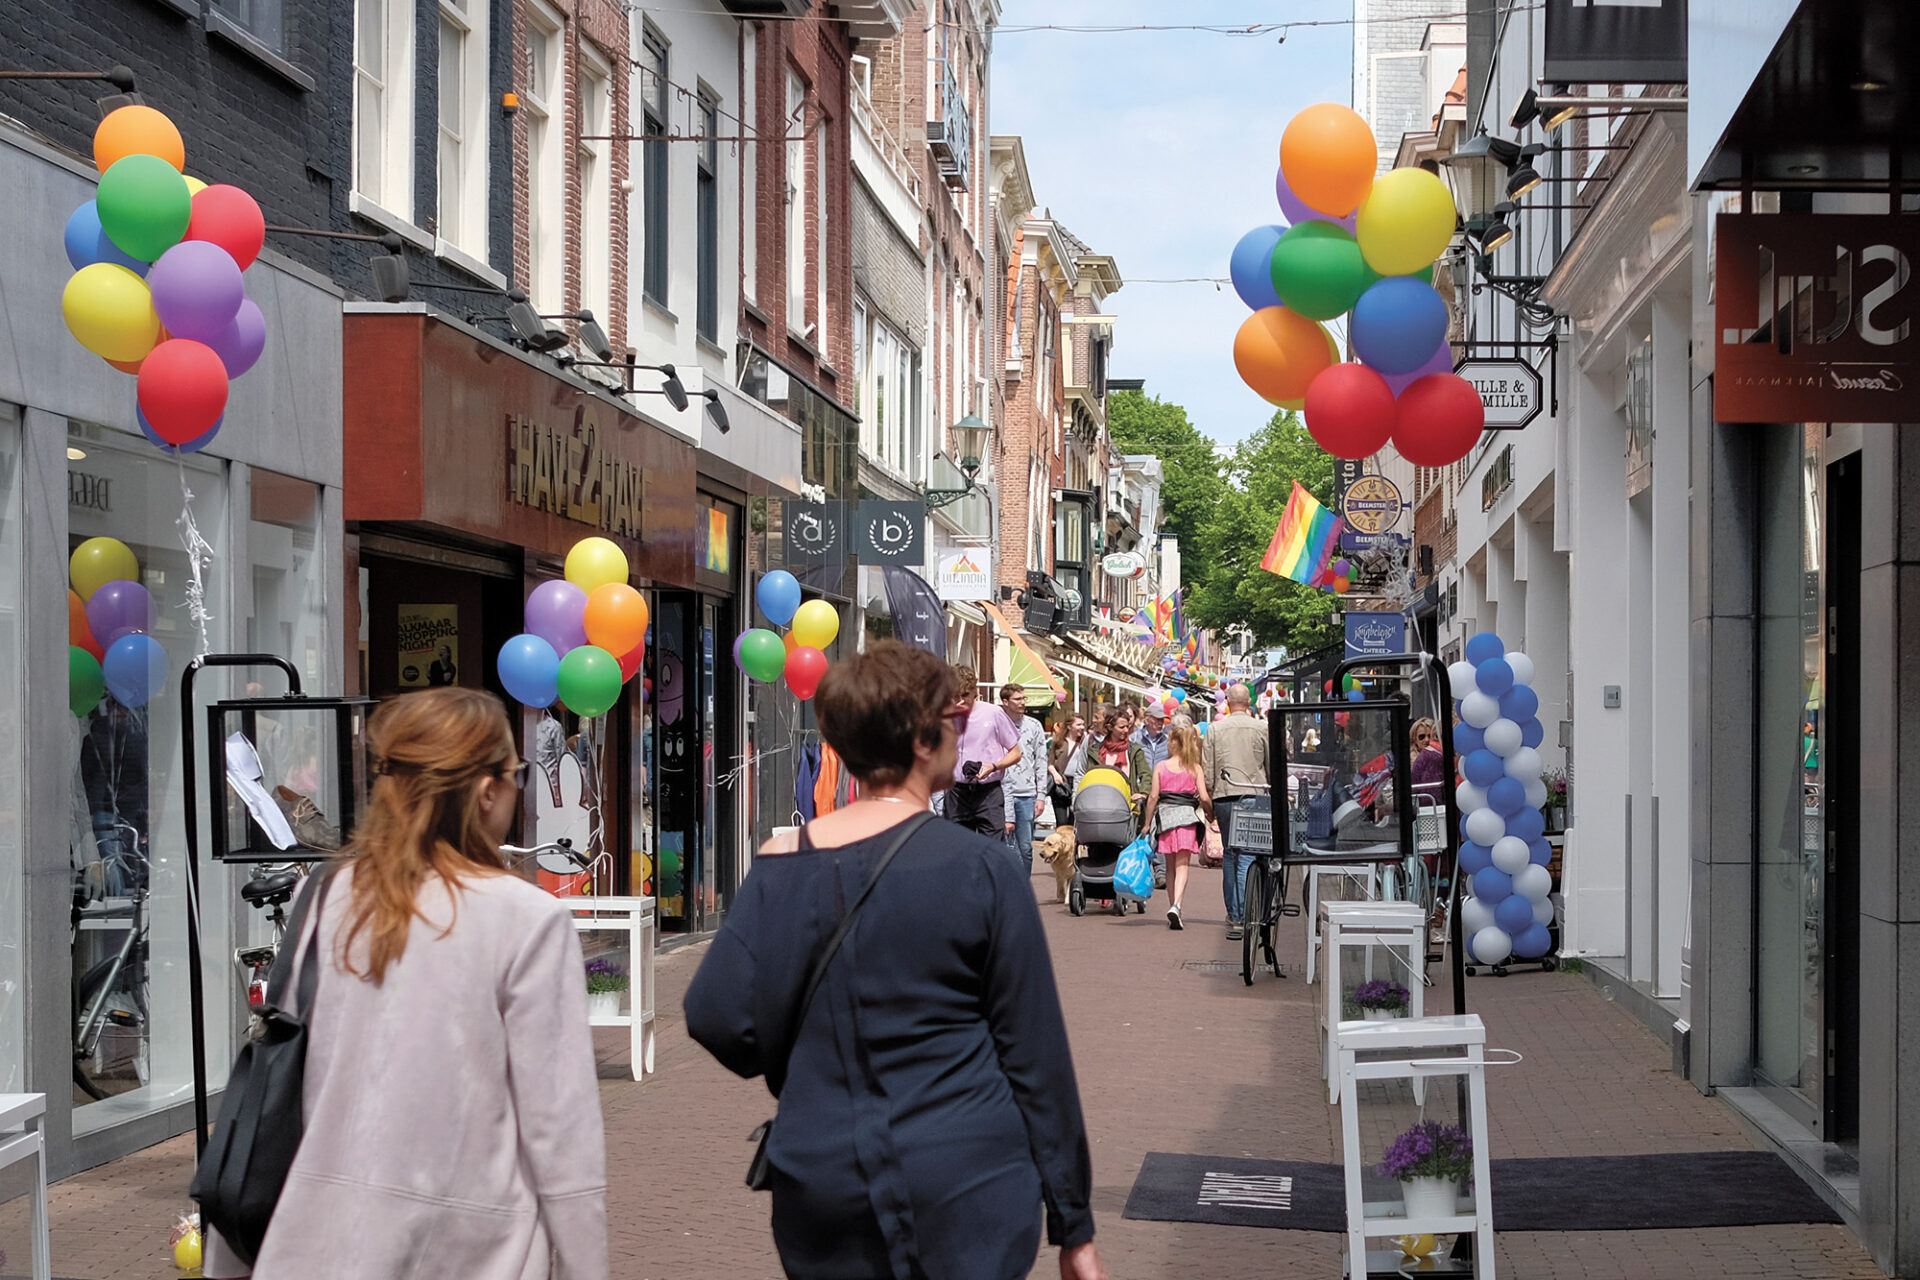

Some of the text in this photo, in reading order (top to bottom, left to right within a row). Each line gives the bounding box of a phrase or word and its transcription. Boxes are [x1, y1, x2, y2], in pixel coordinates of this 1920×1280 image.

[1468, 380, 1525, 393] ILLE &
[1482, 395, 1528, 408] MILLE
[397, 618, 452, 633] ALKMAAR
[398, 626, 458, 642] SHOPPING
[399, 638, 437, 652] NIGHT
